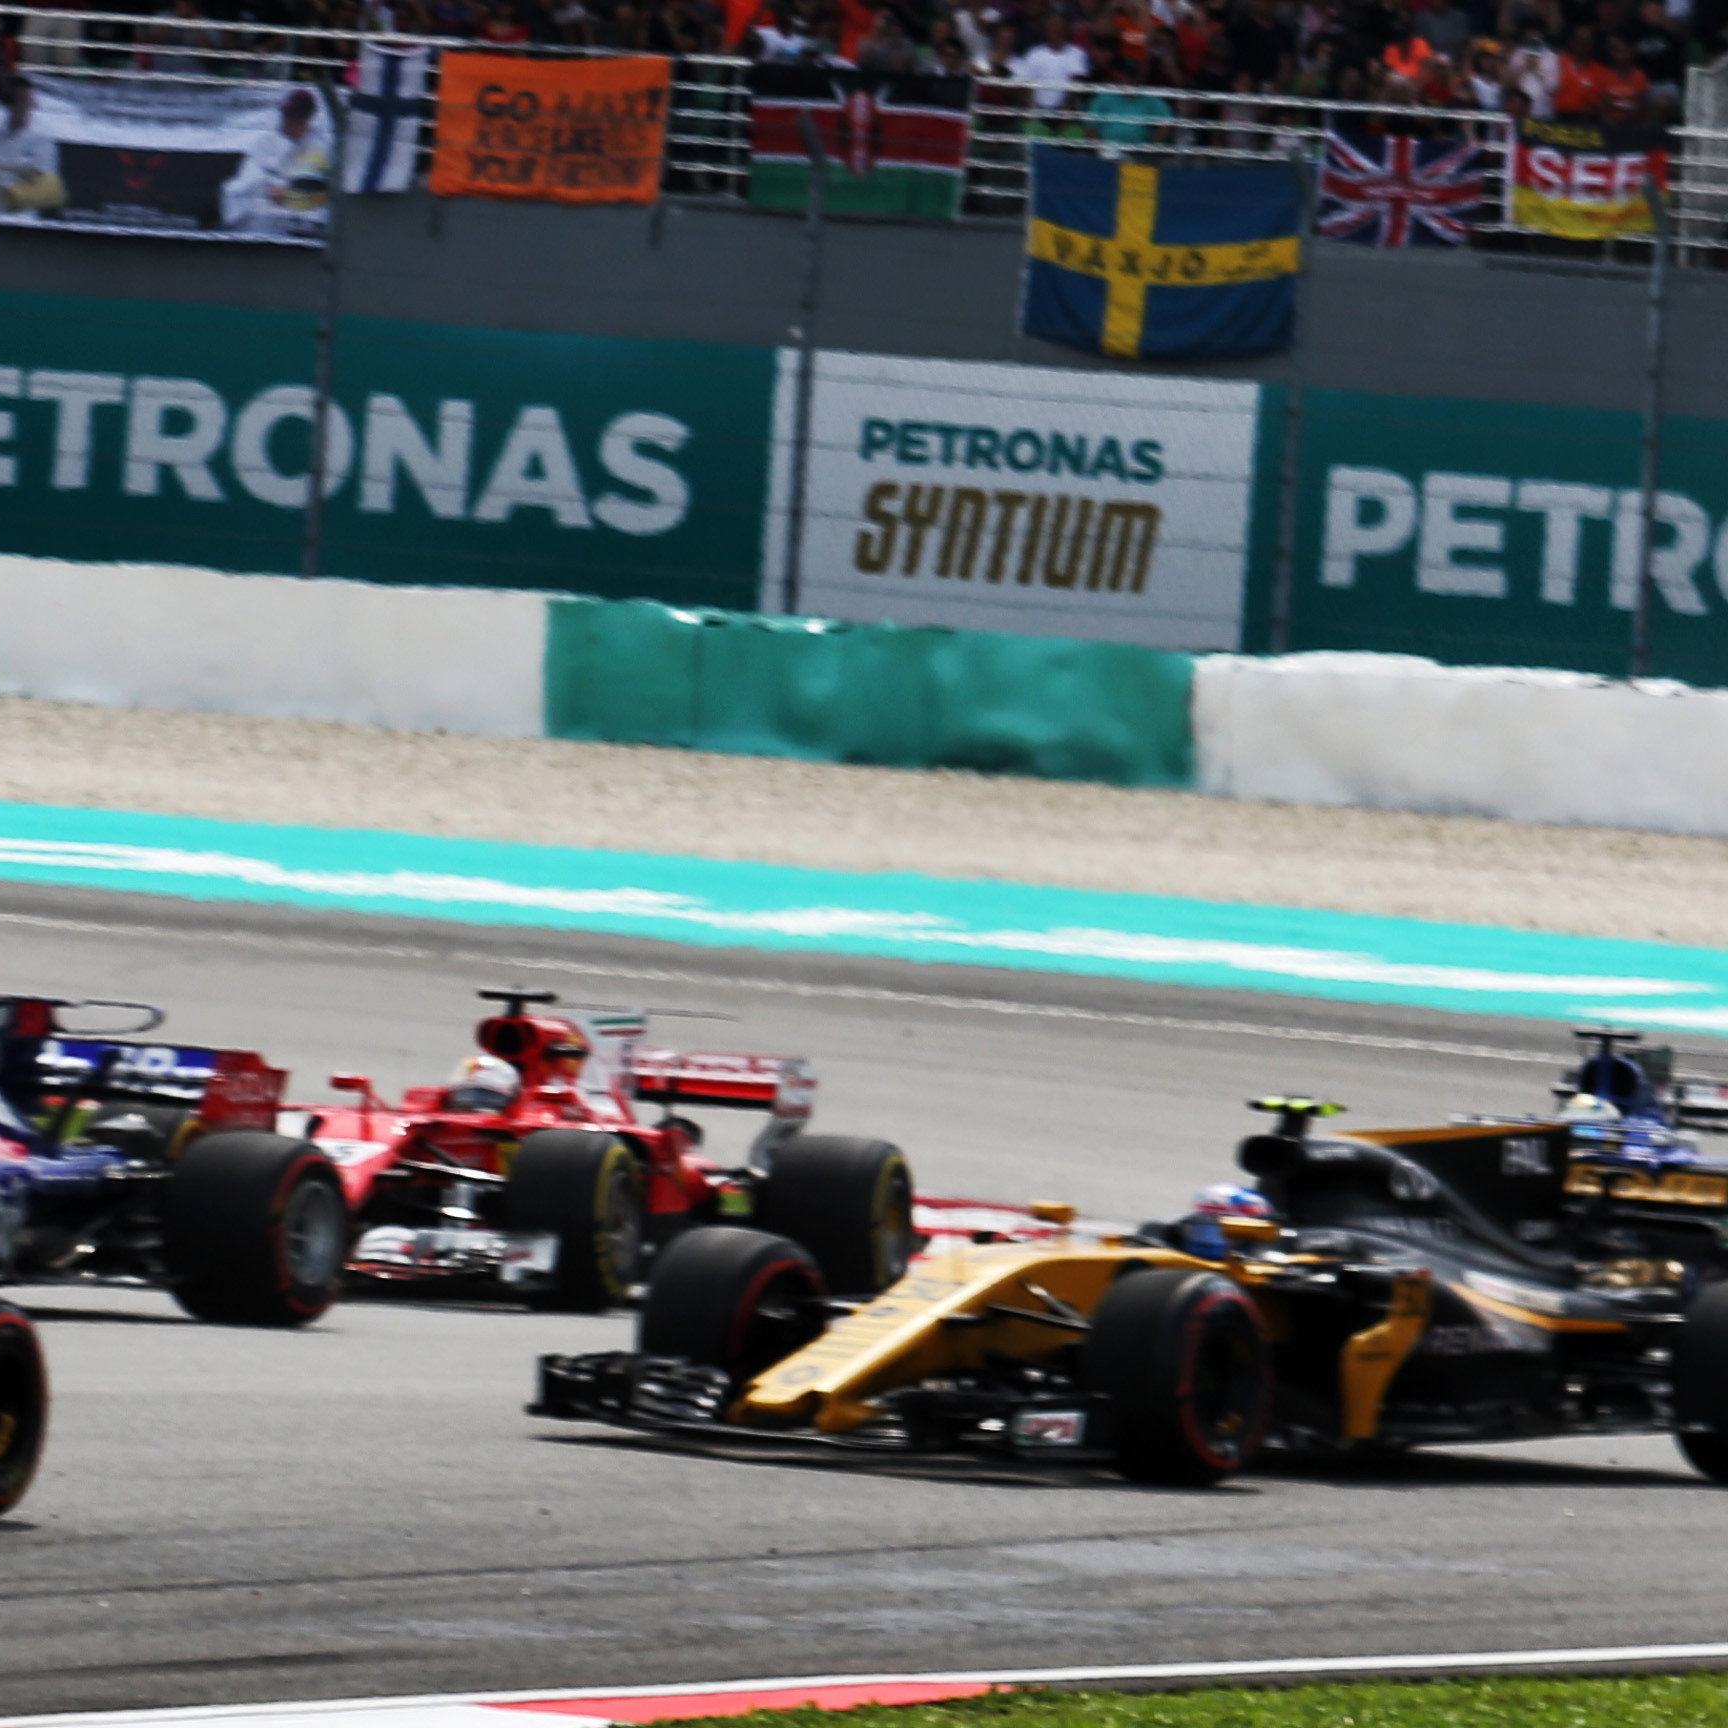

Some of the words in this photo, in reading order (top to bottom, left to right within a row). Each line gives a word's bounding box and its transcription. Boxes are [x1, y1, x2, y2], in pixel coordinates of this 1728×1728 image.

[476, 84, 540, 123] GO
[861, 418, 1164, 484] PETRONAS
[854, 480, 1161, 596] SYNTIUM
[1319, 466, 1728, 617] PETR
